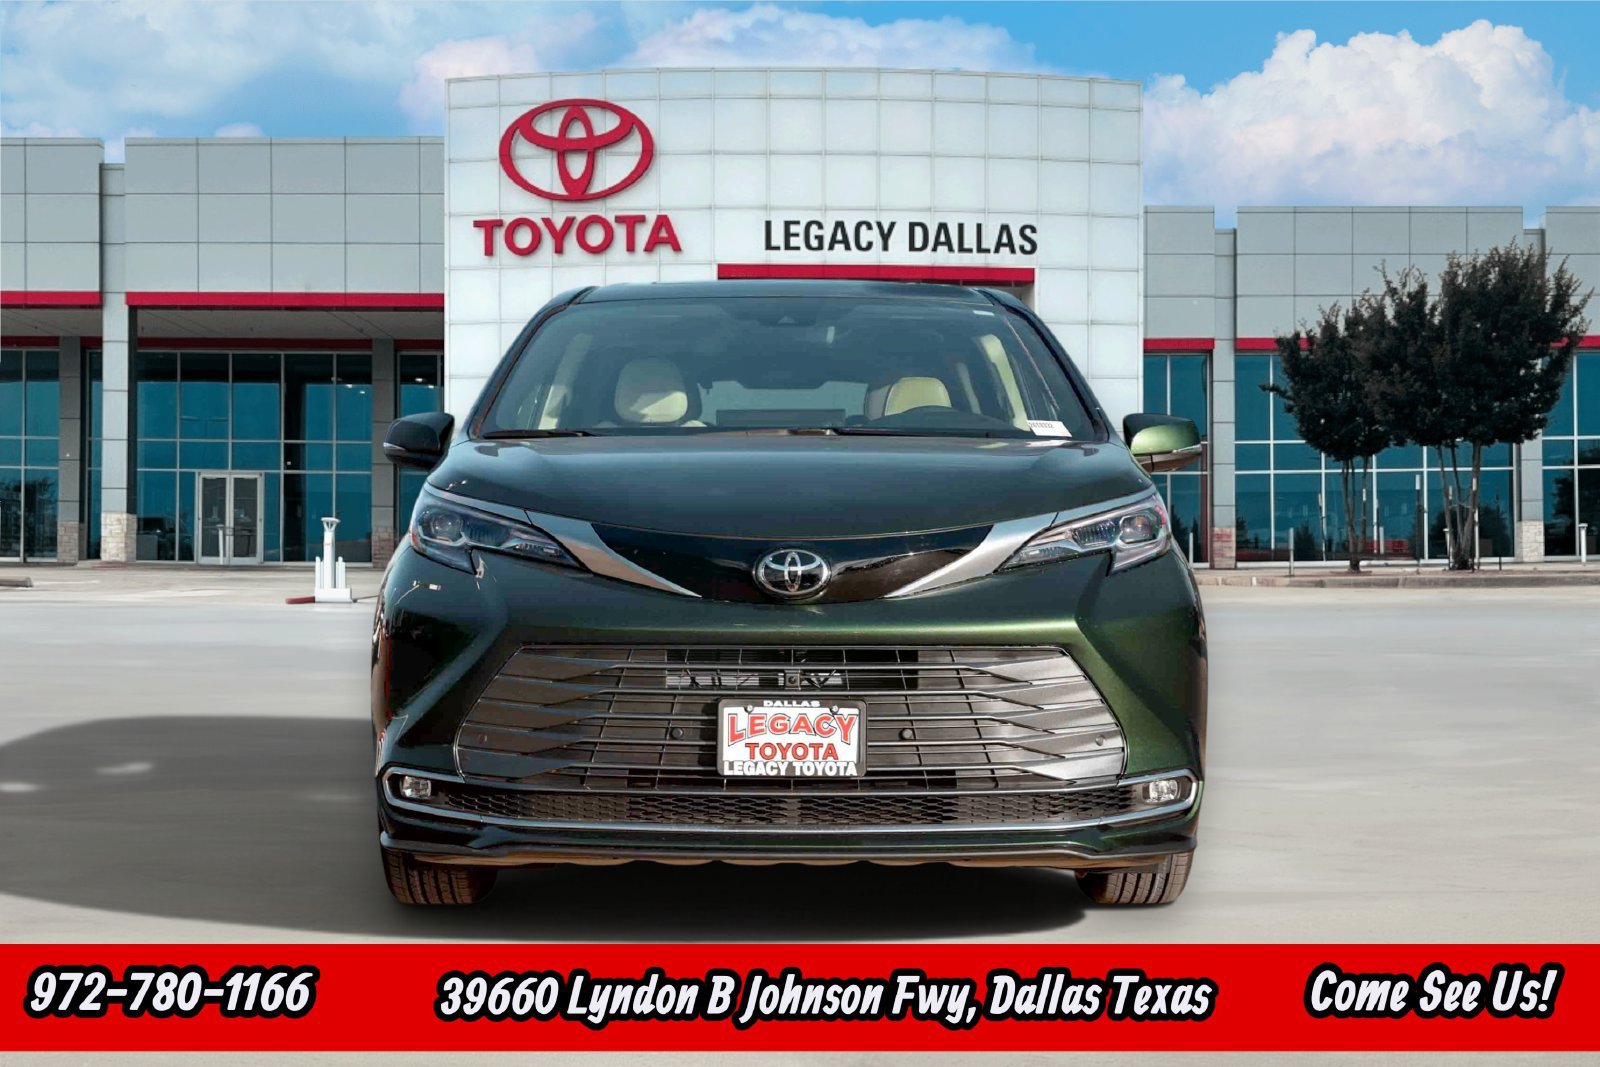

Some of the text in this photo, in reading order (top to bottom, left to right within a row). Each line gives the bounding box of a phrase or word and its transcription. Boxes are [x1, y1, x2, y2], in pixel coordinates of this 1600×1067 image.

[473, 213, 682, 257] TOYOTA
[764, 220, 1038, 256] LEGACY DALLAS
[728, 713, 859, 747] LEGACY
[723, 760, 858, 776] LEGACY TOYOTA
[745, 742, 839, 761] TOYOTA
